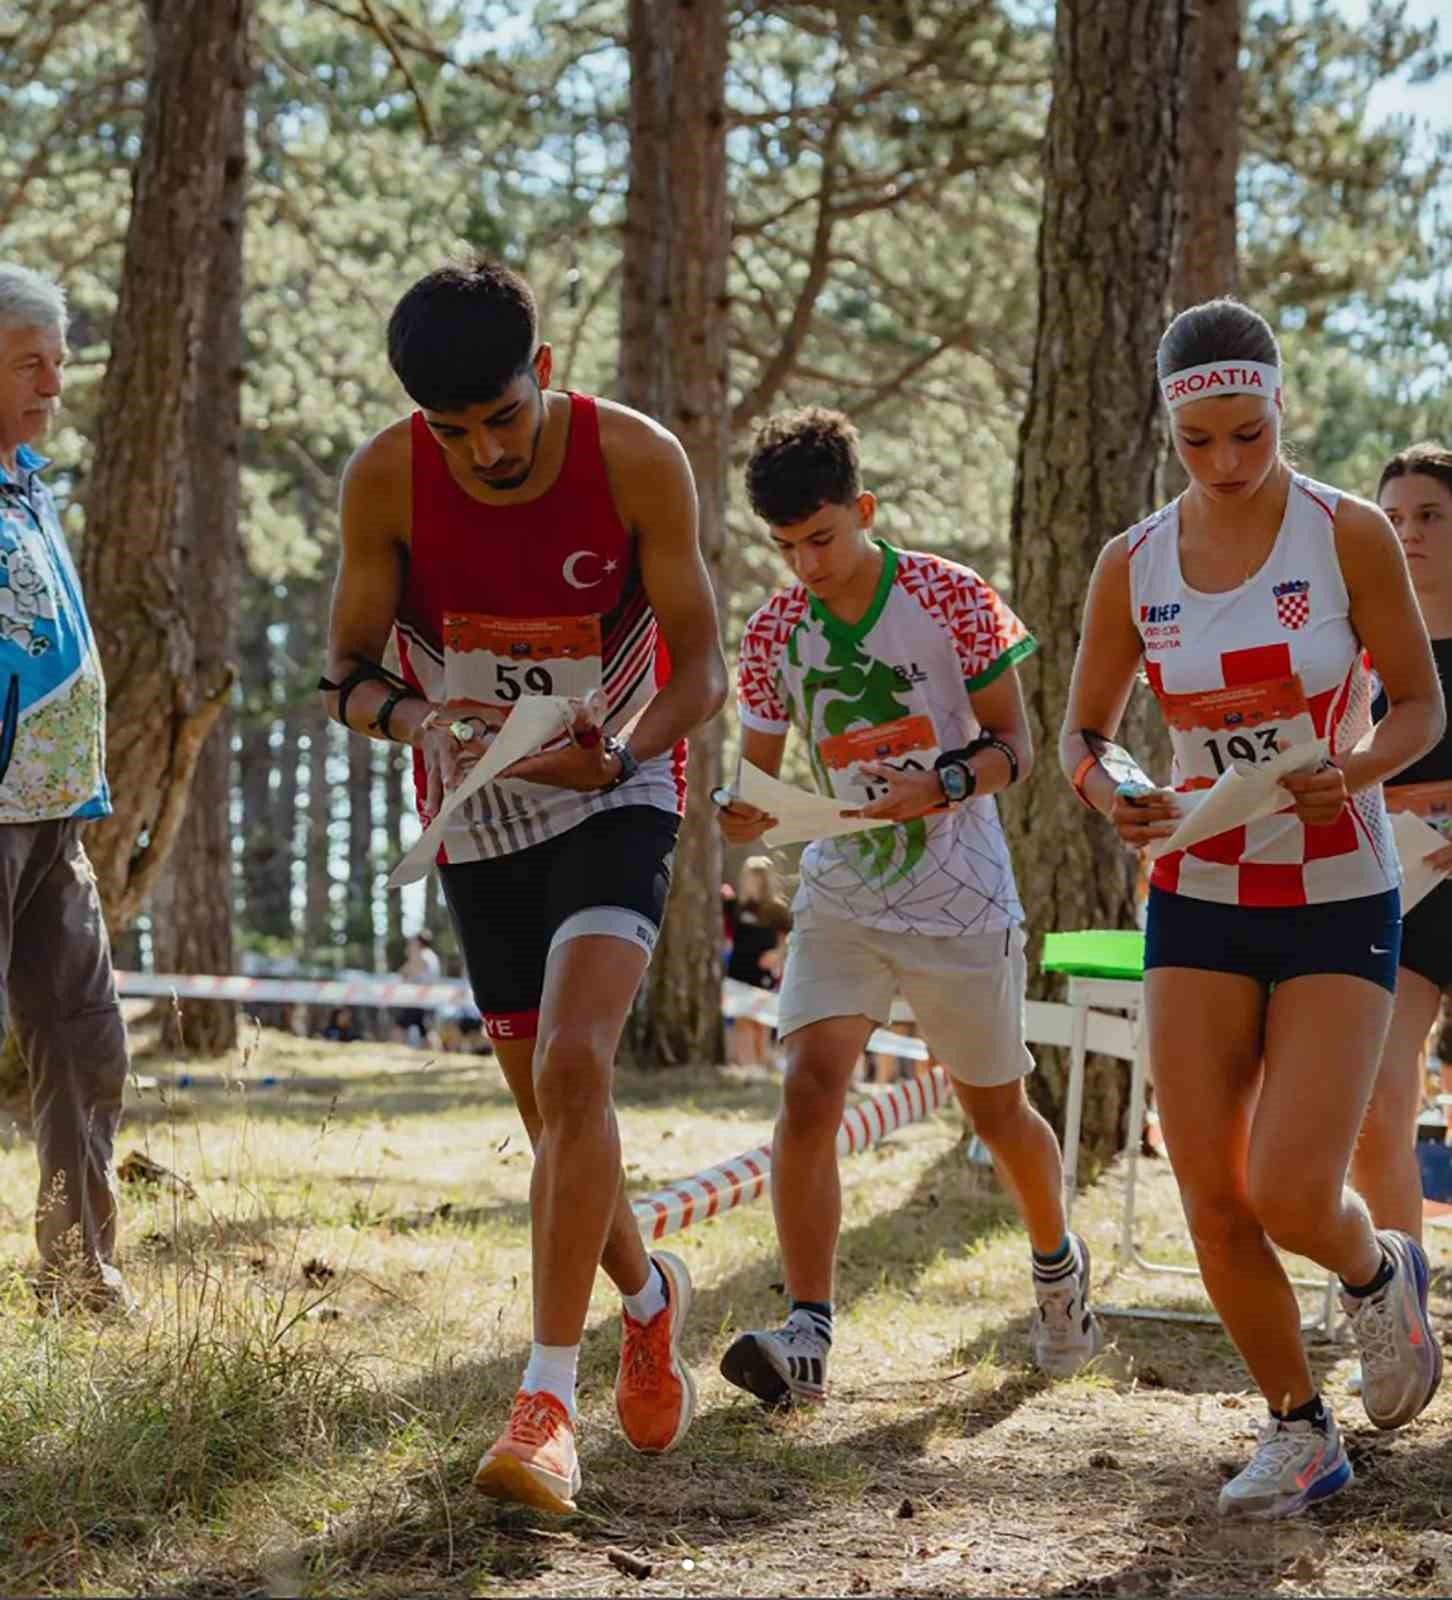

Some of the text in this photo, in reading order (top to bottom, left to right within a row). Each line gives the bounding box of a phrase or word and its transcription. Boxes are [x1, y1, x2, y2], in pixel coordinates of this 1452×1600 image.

[1167, 368, 1263, 400] CROATIA
[495, 664, 553, 701] 59
[1203, 728, 1280, 775] 193
